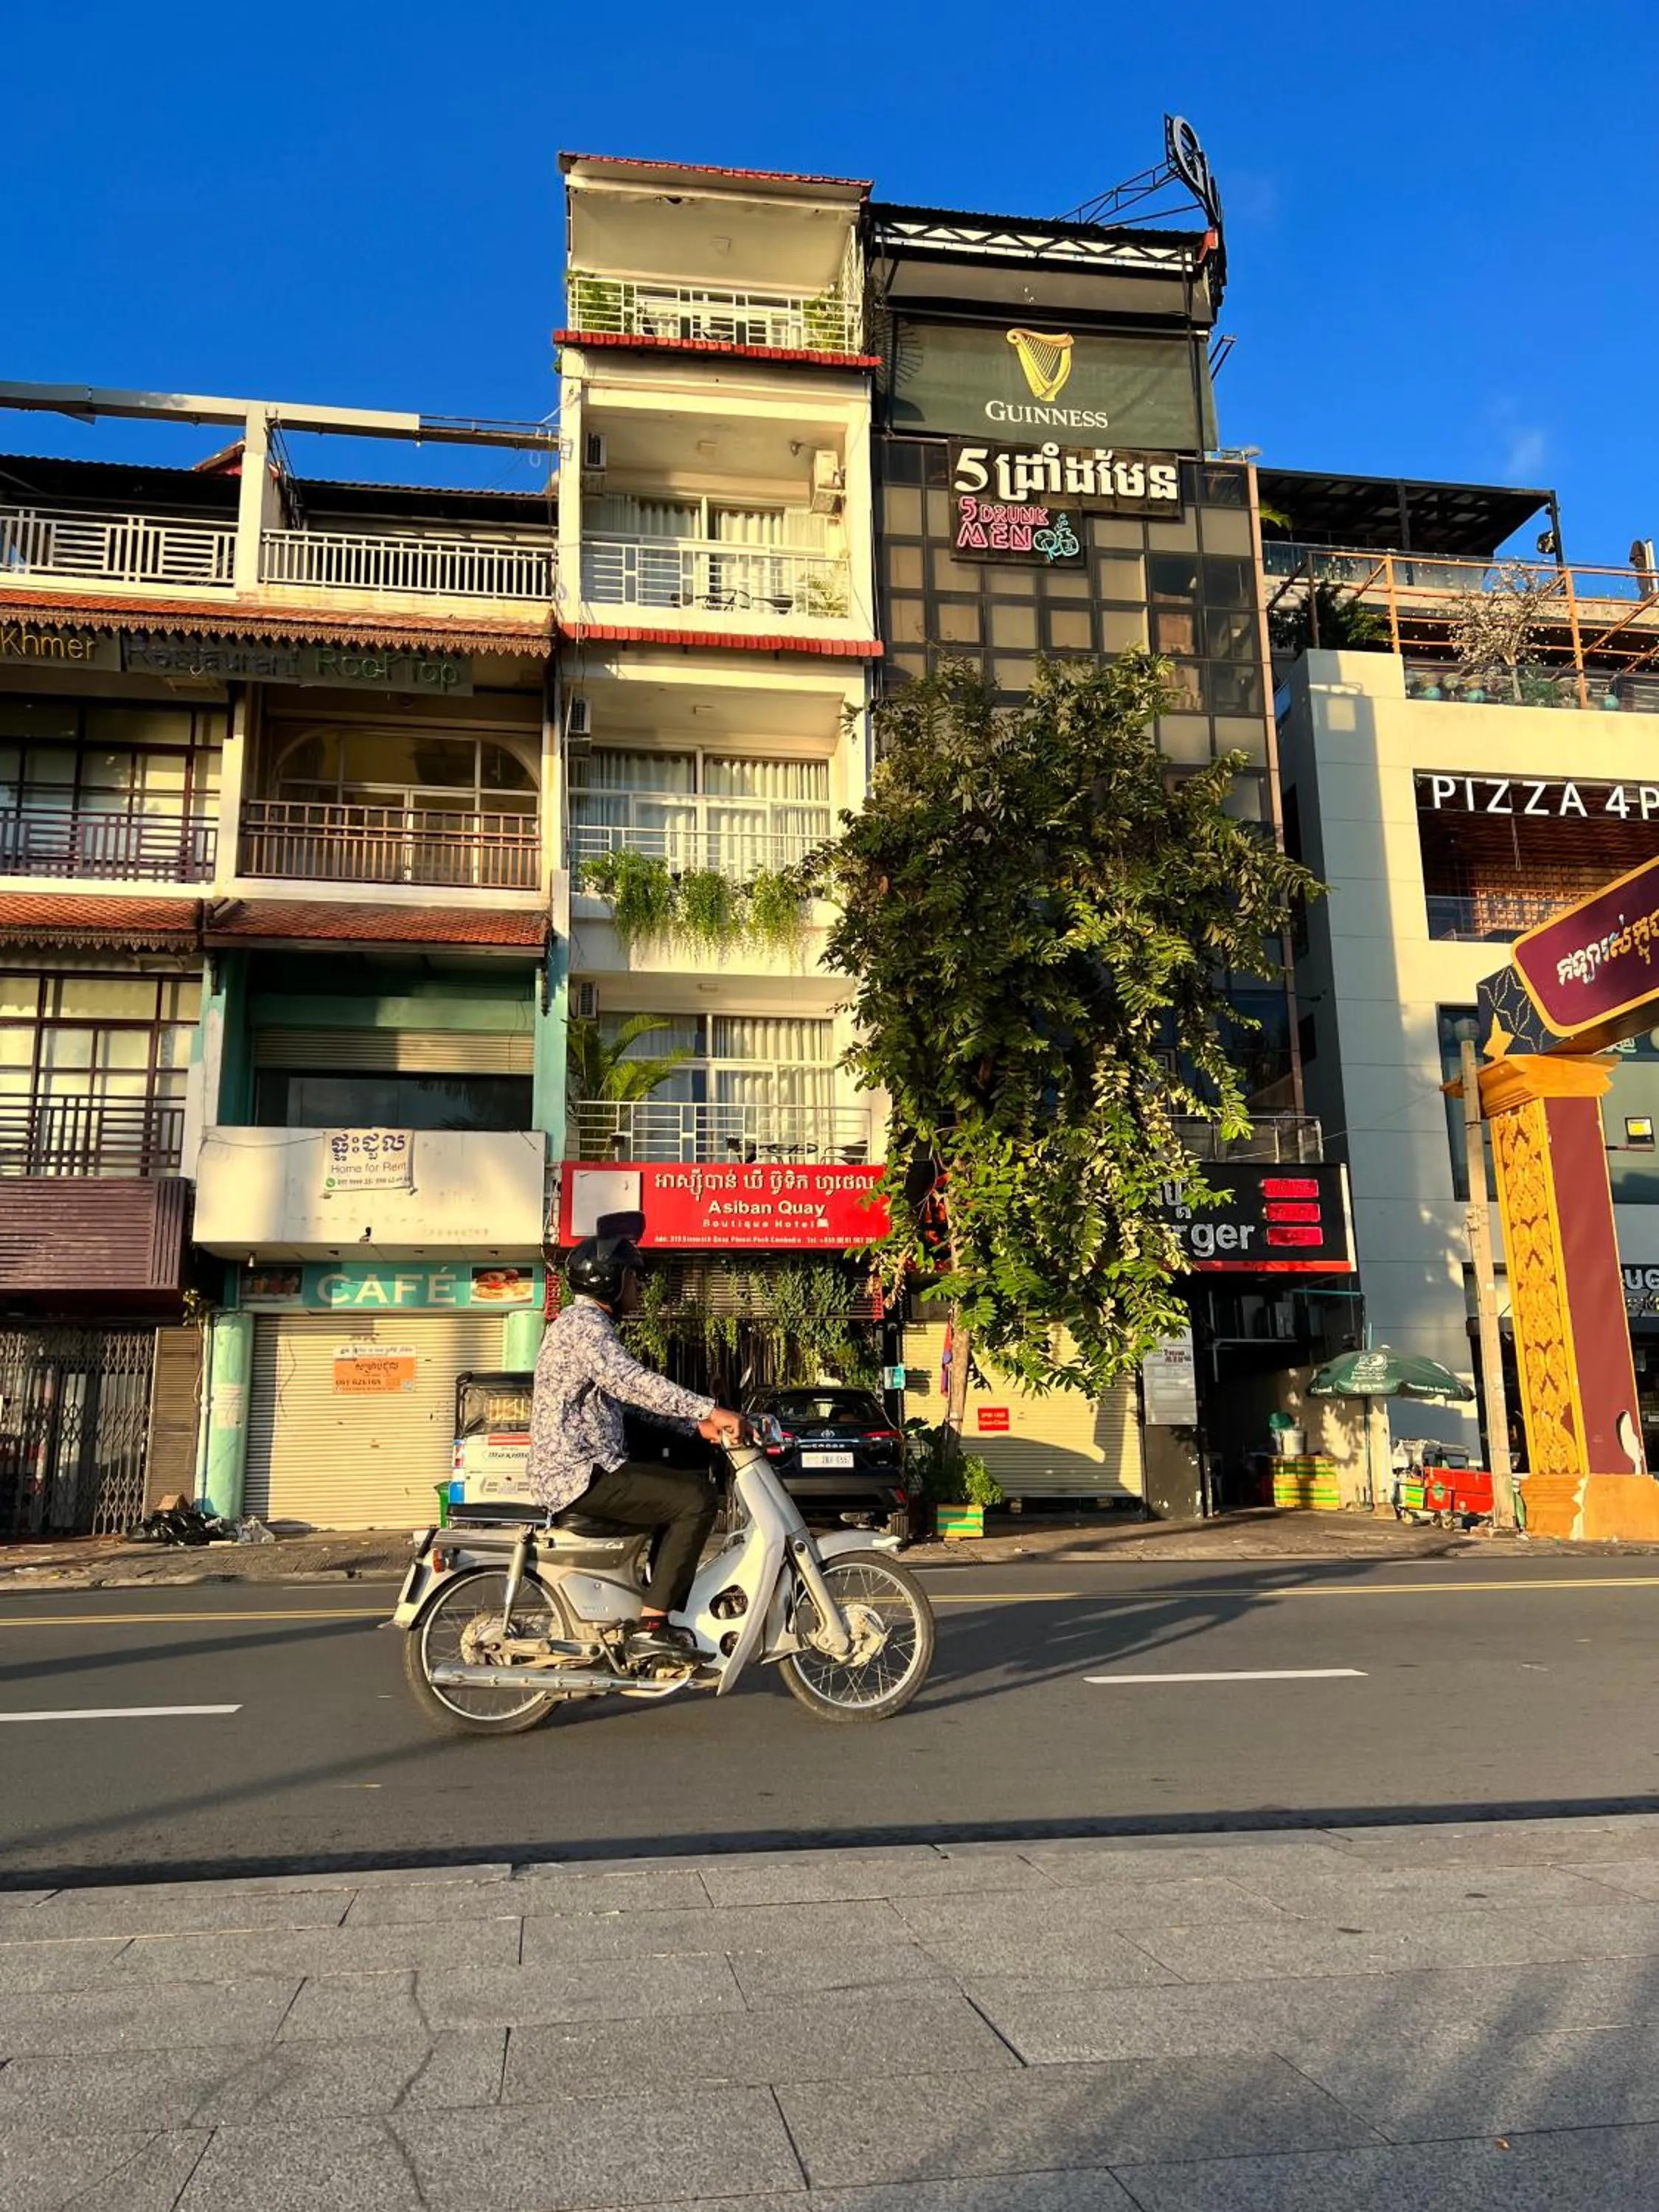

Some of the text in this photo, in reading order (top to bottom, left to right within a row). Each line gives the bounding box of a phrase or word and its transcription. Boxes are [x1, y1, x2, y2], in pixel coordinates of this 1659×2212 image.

[985, 400, 1108, 428] GUINNESS
[980, 504, 1049, 526] DRUNK
[958, 521, 1032, 551] MEN
[1, 627, 94, 660] Khmer
[1433, 775, 1587, 817] PIZZA
[331, 1161, 407, 1174] Home for Rent
[709, 1200, 825, 1217] Asiban Quay
[703, 1219, 815, 1229] Boutique Hotel
[1171, 1222, 1256, 1257] rger
[316, 1267, 456, 1304] CAFÉ
